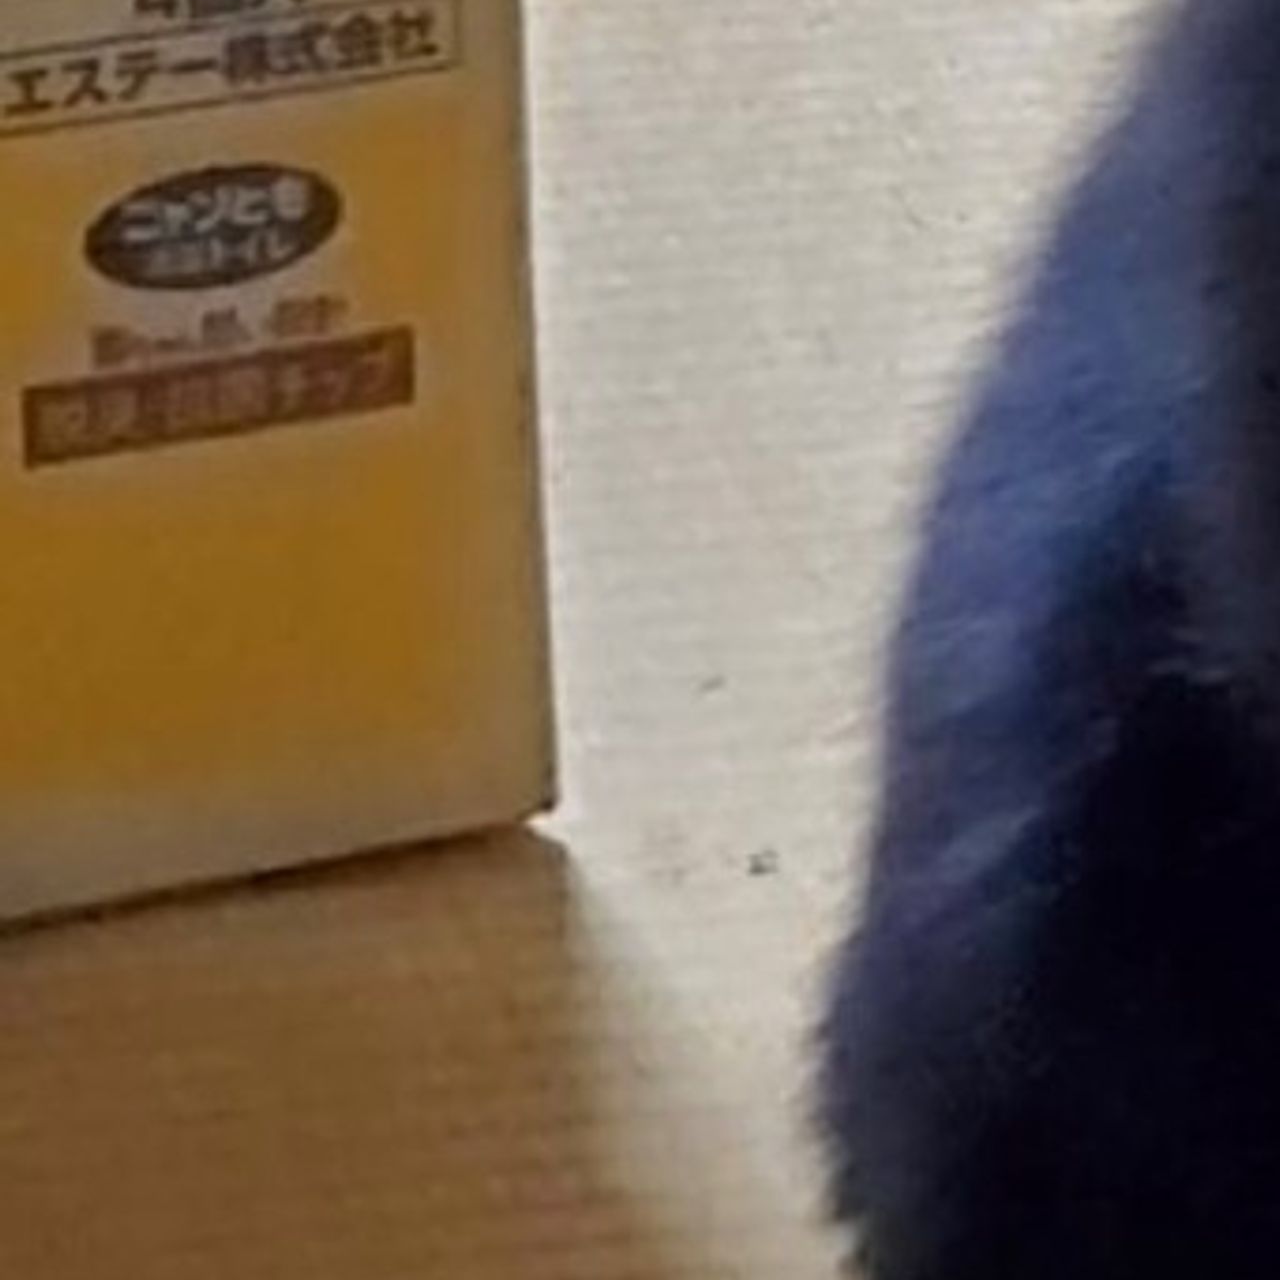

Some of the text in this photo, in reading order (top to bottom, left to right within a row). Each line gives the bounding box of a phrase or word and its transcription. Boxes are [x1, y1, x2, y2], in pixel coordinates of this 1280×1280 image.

[4, 9, 439, 116] エステー株式会社
